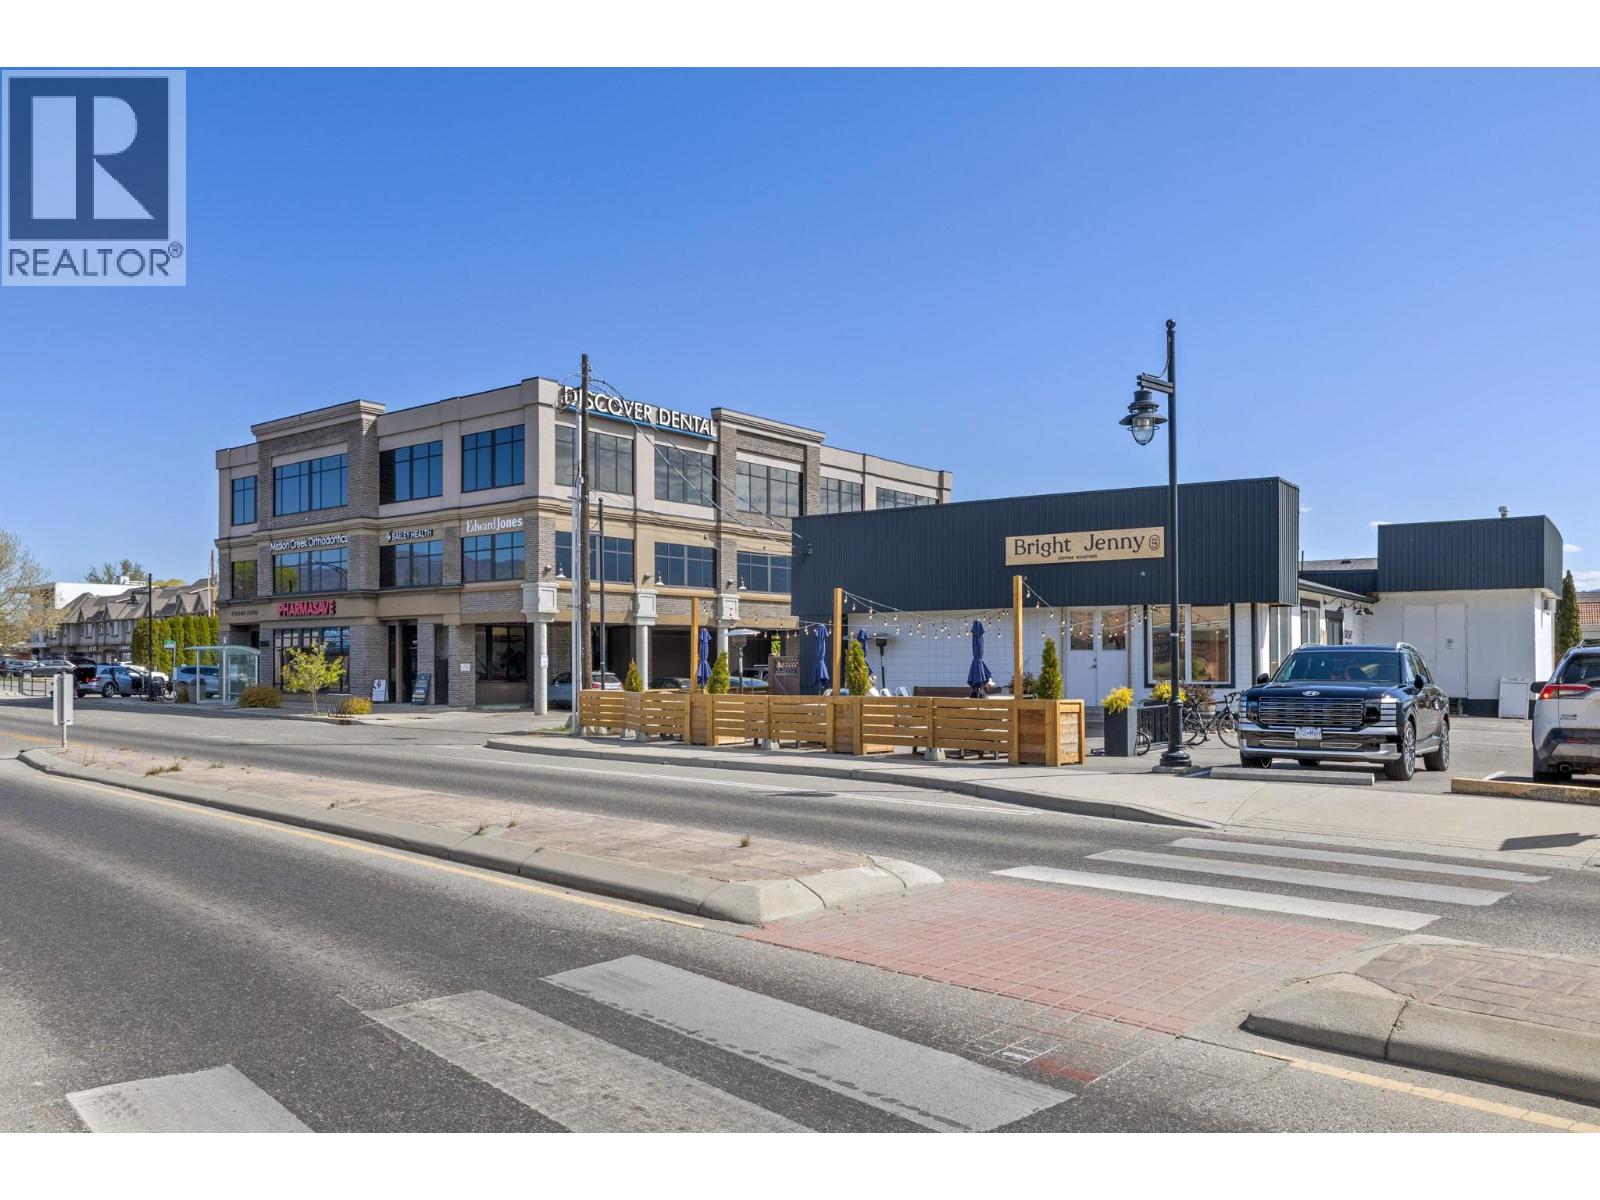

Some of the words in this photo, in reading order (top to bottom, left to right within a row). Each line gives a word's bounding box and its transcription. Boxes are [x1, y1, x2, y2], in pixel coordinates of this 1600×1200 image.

[565, 386, 652, 421] DISCOVER
[658, 407, 717, 437] DENTAL
[290, 538, 308, 549] Creek
[308, 533, 349, 547] Orthodontics
[410, 529, 433, 539] HEALTH
[1014, 536, 1072, 558] Bright
[1084, 534, 1145, 553] Jenny
[277, 600, 337, 616] PHARMASAVE
